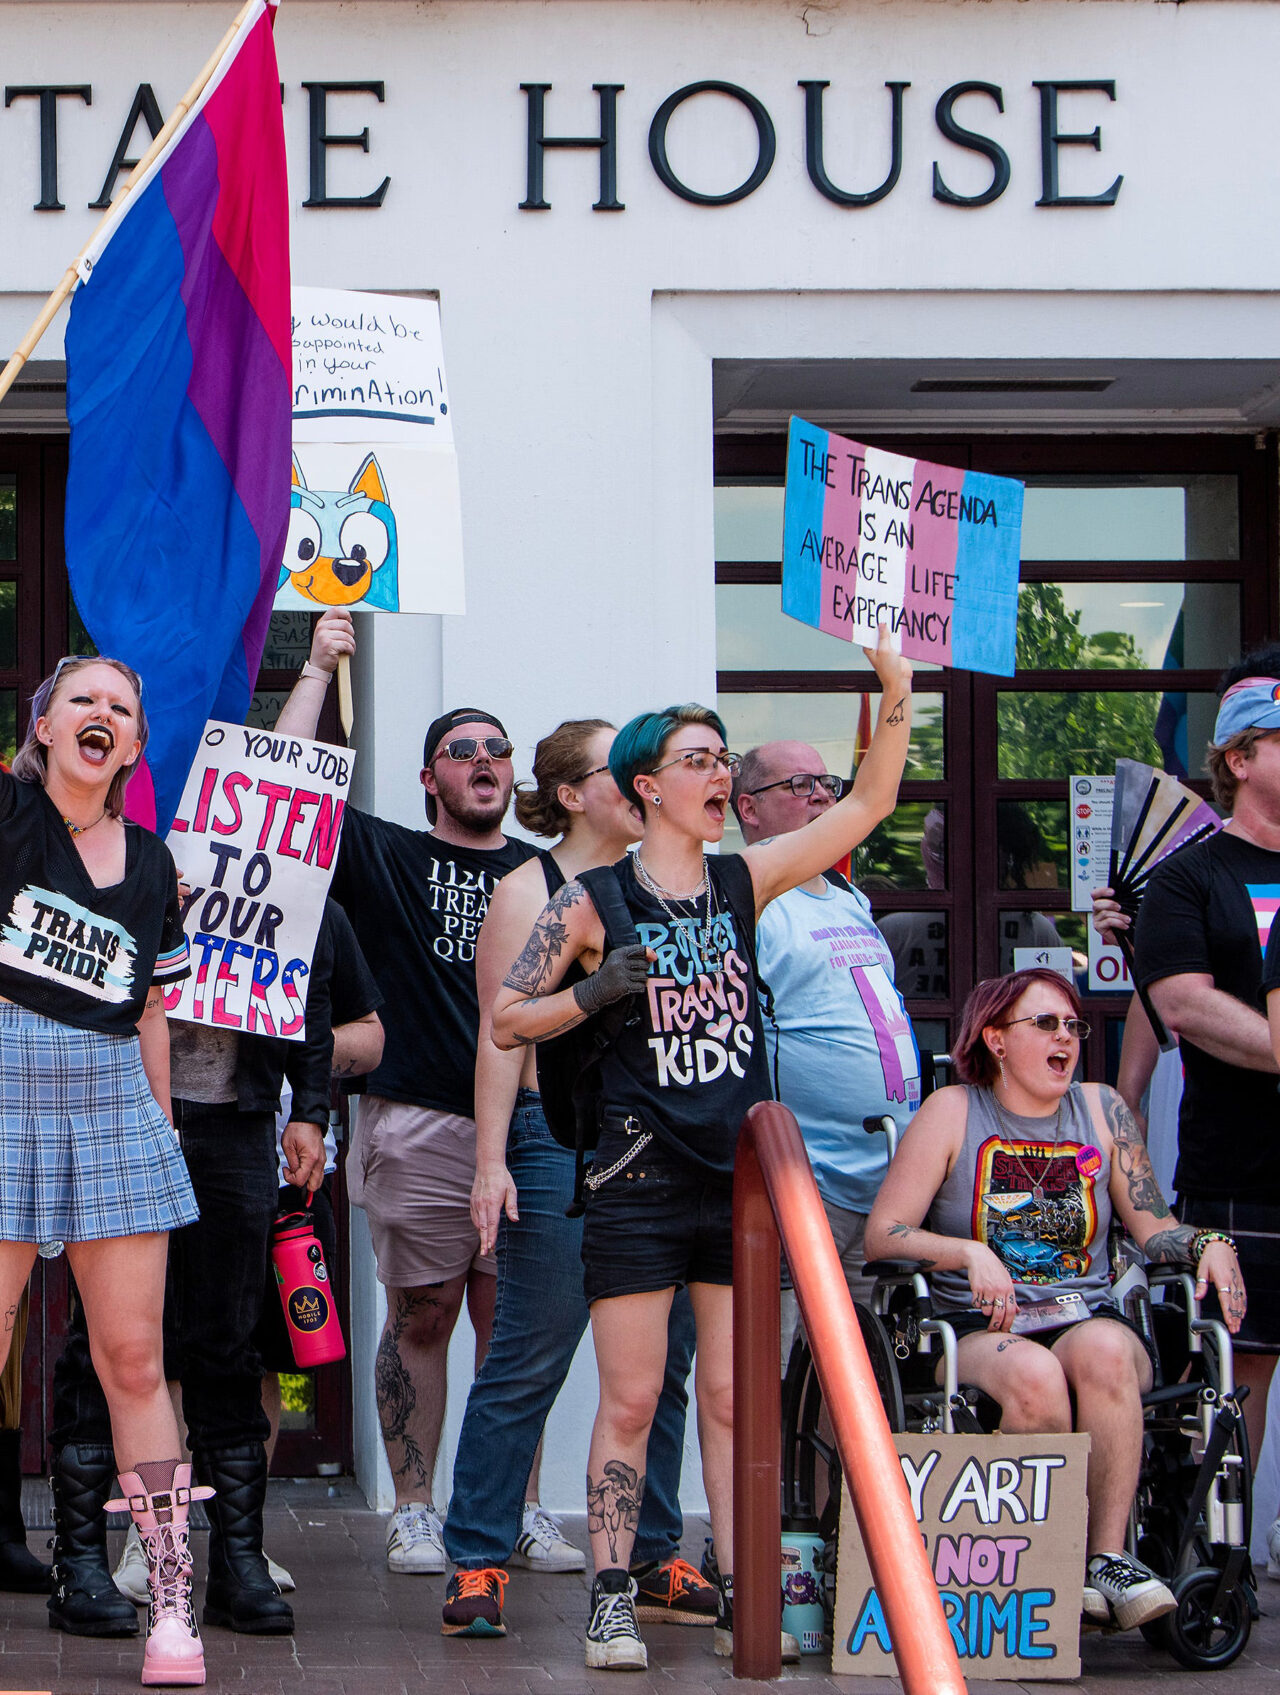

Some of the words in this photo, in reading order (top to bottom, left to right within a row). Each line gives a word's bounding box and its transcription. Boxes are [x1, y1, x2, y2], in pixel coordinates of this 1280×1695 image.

[518, 79, 1124, 213] HOUSE
[292, 337, 384, 356] sappointed
[312, 313, 386, 334] would
[390, 315, 423, 341] be
[299, 353, 316, 370] in
[323, 356, 377, 377] your
[800, 438, 837, 489] THE
[847, 454, 912, 510] TRANS
[915, 480, 997, 528] AGENDA
[858, 510, 876, 541] IS
[884, 519, 914, 550] AN
[800, 528, 888, 584] AVERAGE
[911, 564, 959, 601] LIFE
[833, 585, 952, 646] EXPECTANCY
[205, 728, 226, 747] O
[243, 730, 303, 768] YOUR
[307, 747, 349, 786] JOB
[210, 840, 271, 897] TO
[179, 882, 284, 950] YOUR
[429, 884, 488, 919] TREA
[31, 900, 120, 963] TRANS
[433, 936, 477, 963] QU
[635, 911, 737, 986] PROTECT
[23, 932, 109, 989] PRIDE
[829, 955, 848, 969] FOR
[647, 949, 749, 1032] TRANS
[994, 1156, 1078, 1182] STRANGER
[1009, 1174, 1057, 1191] THIGS
[898, 1450, 941, 1522] Y
[939, 1454, 1066, 1525] ART
[934, 1533, 1031, 1587] NOT
[847, 1588, 892, 1655] A
[939, 1588, 1057, 1659] RIME
